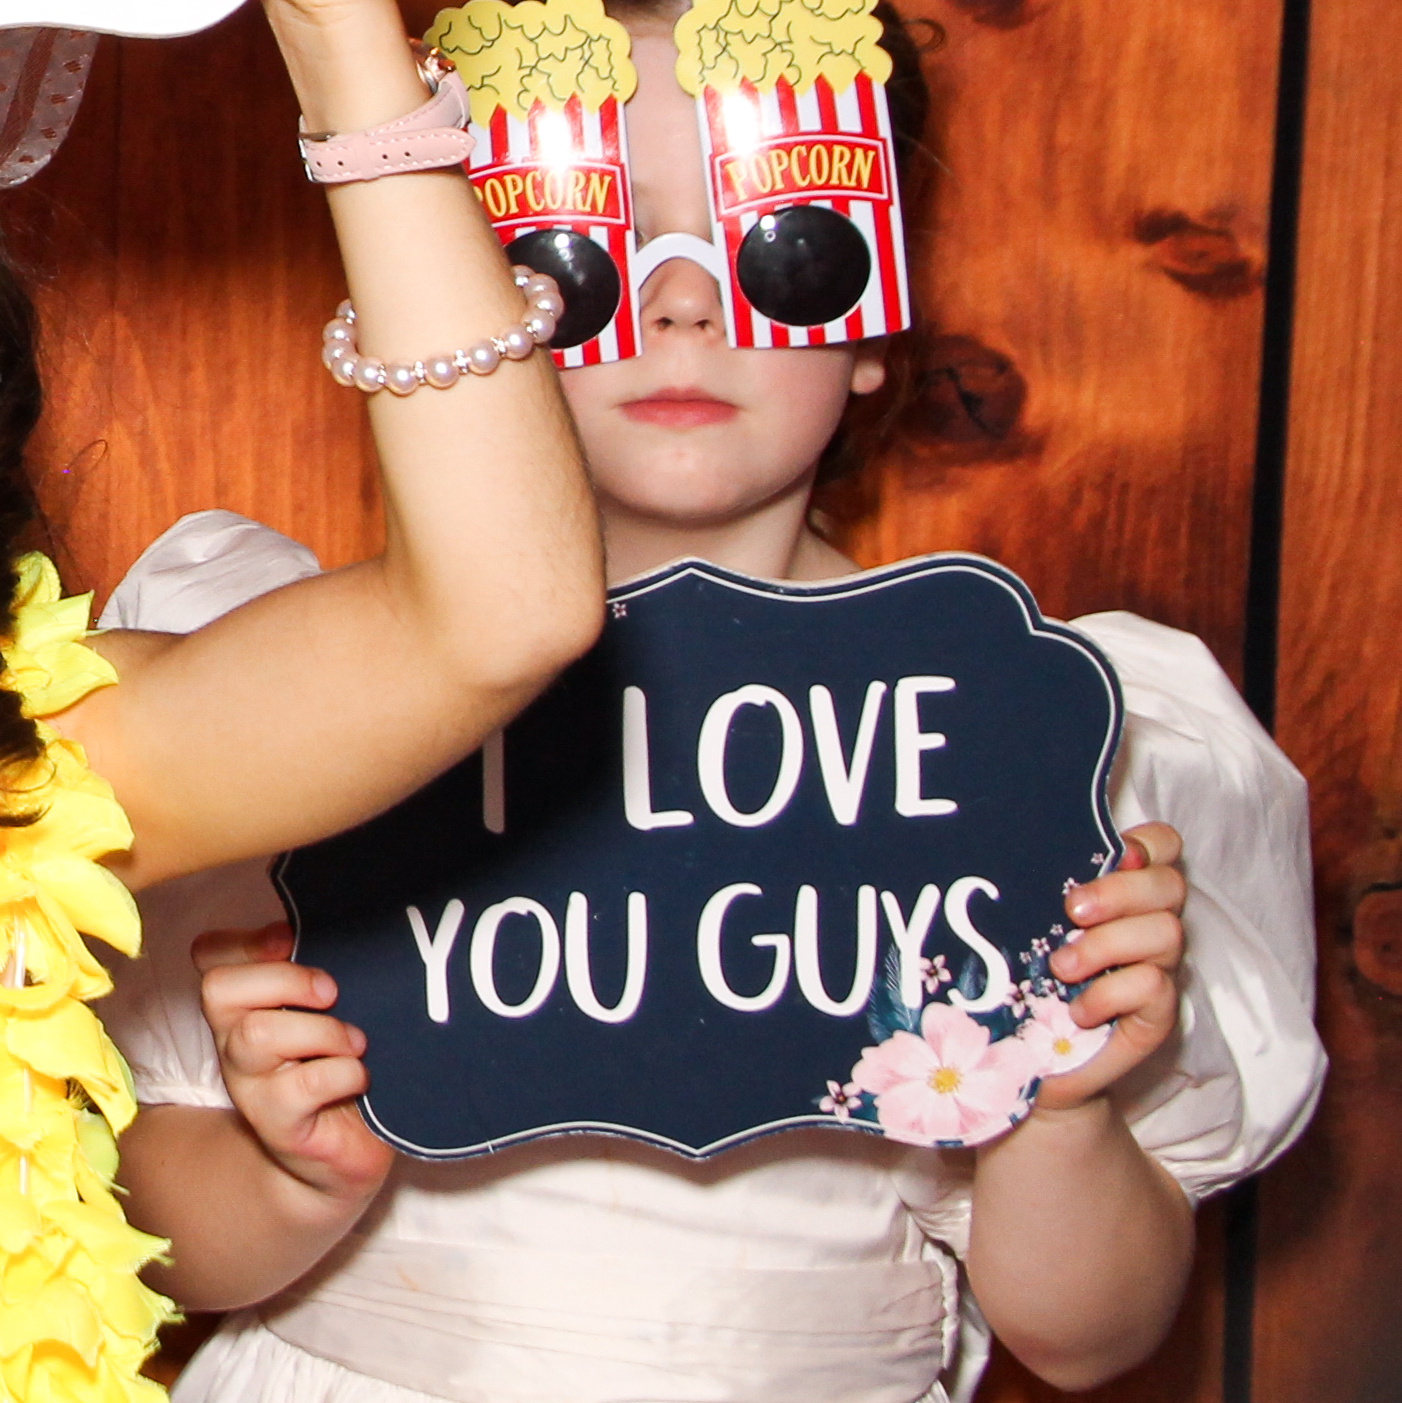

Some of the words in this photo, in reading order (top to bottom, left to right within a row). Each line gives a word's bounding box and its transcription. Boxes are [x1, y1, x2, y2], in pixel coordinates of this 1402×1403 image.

[724, 143, 877, 202] POPCORN
[481, 727, 506, 835] I
[622, 674, 959, 832] LOVE
[406, 890, 649, 1025] YOU
[696, 875, 1012, 1017] GUYS
